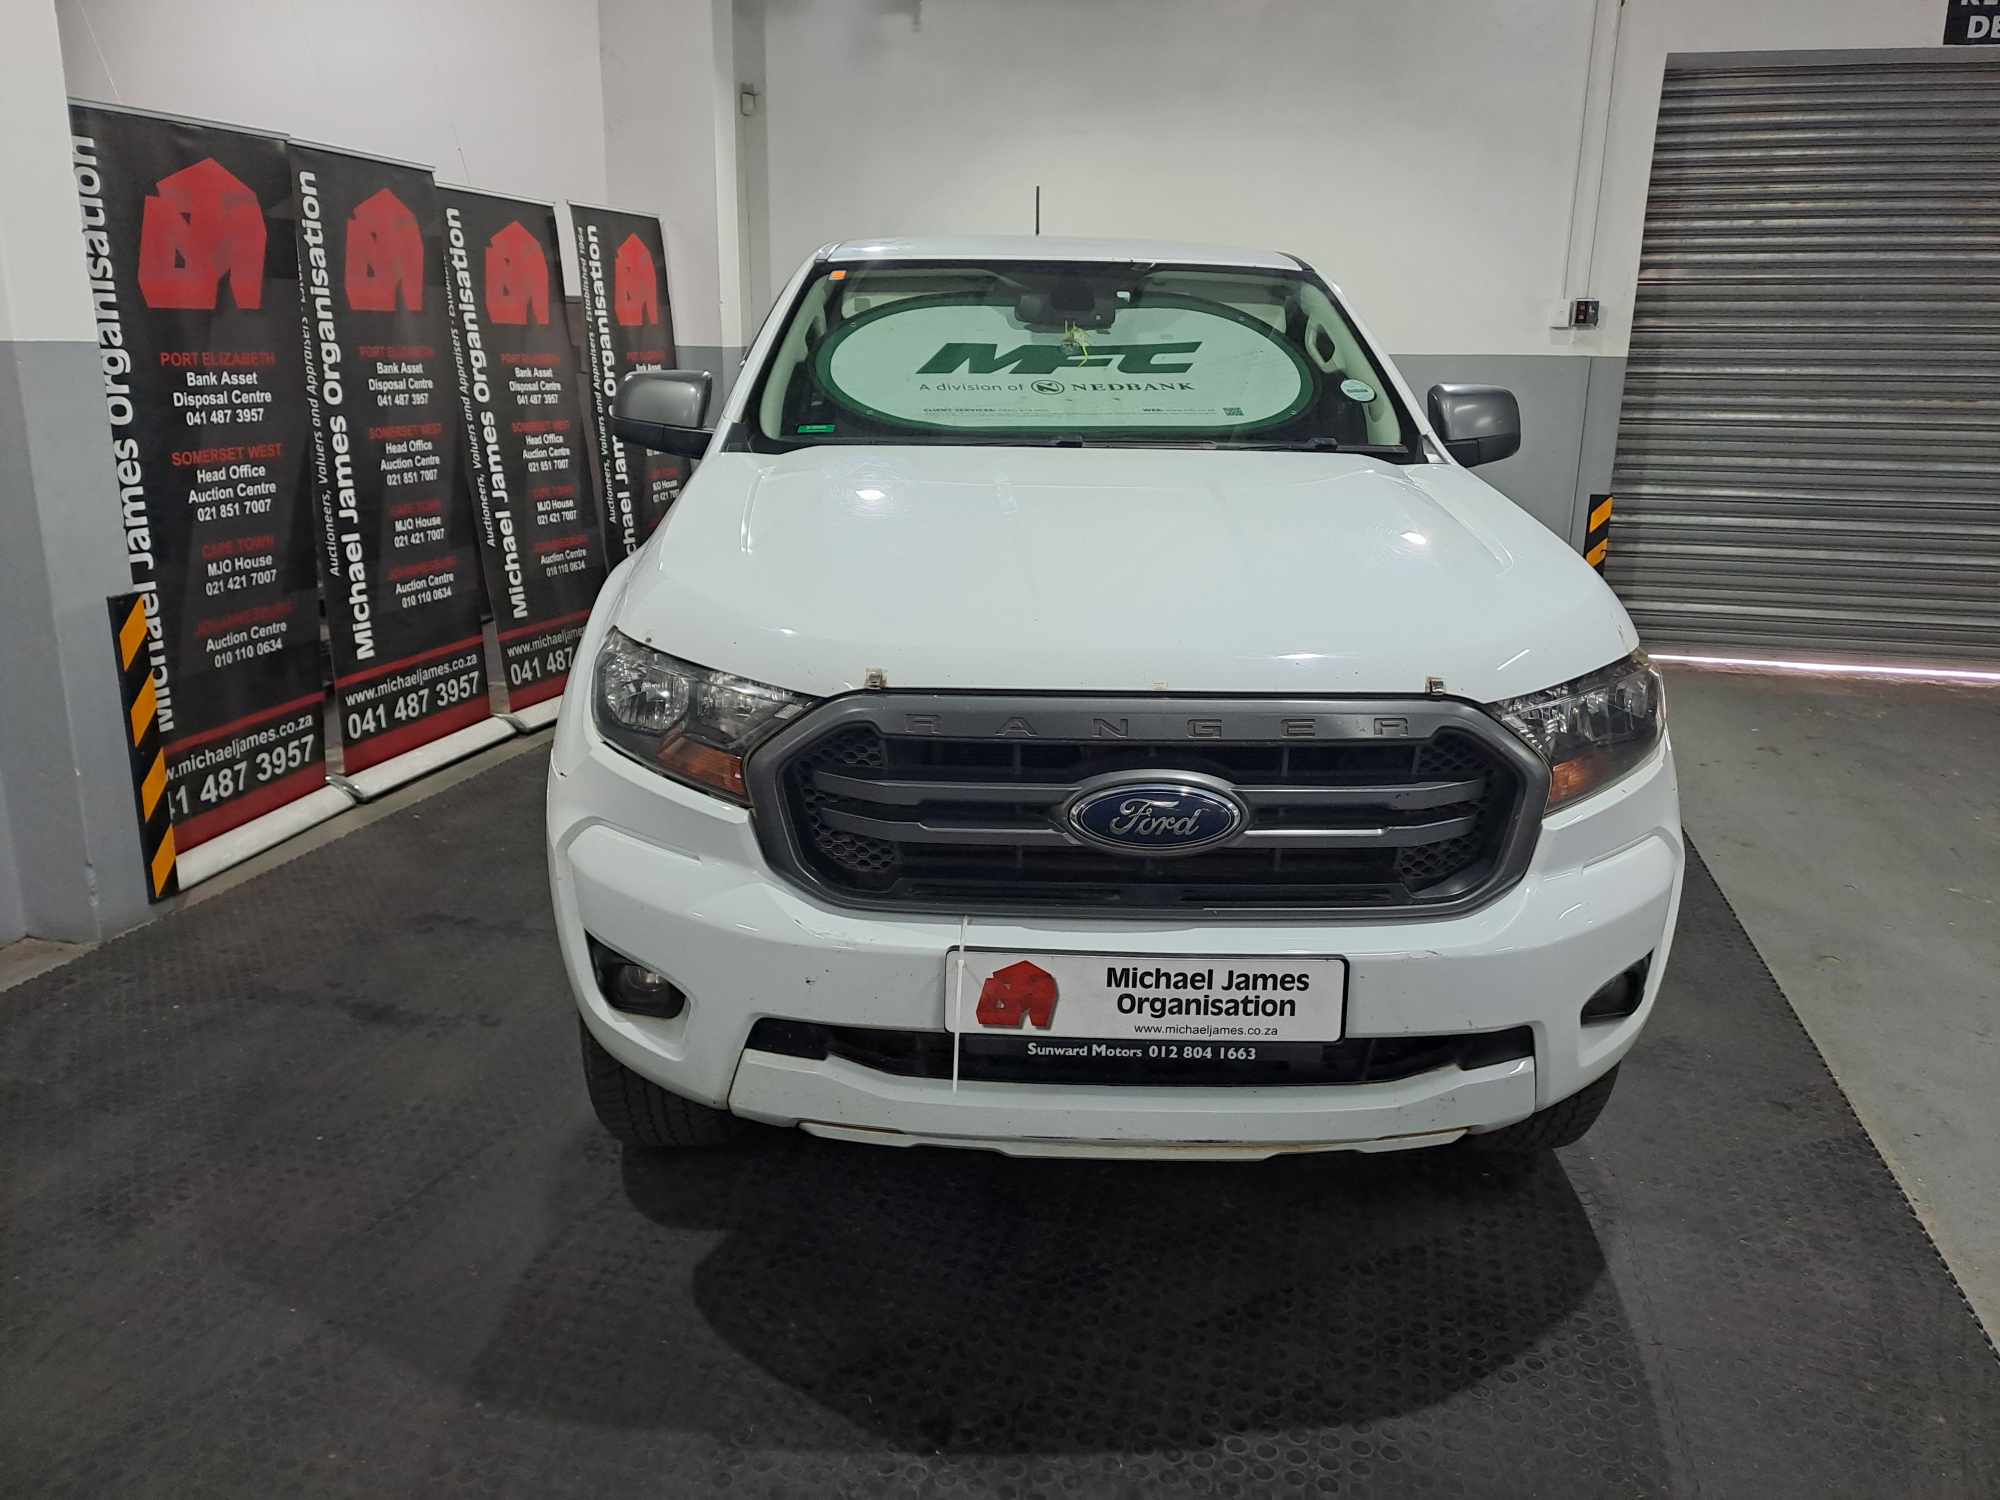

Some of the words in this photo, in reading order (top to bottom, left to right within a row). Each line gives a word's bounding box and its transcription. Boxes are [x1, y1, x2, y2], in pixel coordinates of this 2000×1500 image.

[299, 171, 343, 407] Organisation
[446, 207, 491, 403] Organisation
[586, 224, 617, 397] Organisation
[160, 352, 198, 367] PORT
[376, 362, 399, 374] Bank
[400, 362, 424, 374] Asset
[915, 341, 1202, 374] MFC
[186, 372, 218, 386] Bank
[220, 371, 258, 385] Asset
[368, 378, 406, 392] Disposal
[408, 378, 434, 390] Centre
[919, 382, 932, 392] A
[936, 382, 1002, 392] division
[1007, 382, 1024, 392] of
[1071, 383, 1195, 392] NEDBANK
[172, 391, 228, 408] Disposal
[231, 390, 272, 404] Centre
[460, 396, 474, 421] and
[186, 411, 207, 426] 041
[210, 410, 232, 424] 487
[236, 408, 264, 423] 3957
[309, 398, 323, 428] and
[171, 447, 243, 466] SOMERSET
[247, 443, 282, 459] WEST
[385, 441, 408, 454] Head
[408, 440, 432, 452] Office
[480, 410, 508, 503] James
[196, 466, 226, 484] Head
[229, 464, 266, 480] Office
[329, 414, 359, 524] James
[380, 458, 413, 471] Auction
[415, 455, 440, 467] Centre
[113, 437, 155, 571] James
[188, 486, 234, 504] Auction
[237, 481, 277, 498] Centre
[197, 507, 217, 522] 021
[220, 502, 240, 519] 851
[243, 499, 272, 516] 7007
[617, 491, 637, 555] chael
[207, 559, 232, 577] MJO
[234, 555, 273, 571] House
[495, 510, 528, 619] Michael
[205, 580, 224, 596] 021
[227, 574, 247, 591] 421
[250, 569, 277, 586] 7007
[395, 579, 427, 595] Auction
[428, 572, 454, 586] Centre
[341, 532, 376, 661] Michael
[206, 630, 248, 652] Auction
[250, 621, 287, 640] Centre
[214, 651, 233, 668] 010
[235, 645, 254, 662] 110
[256, 638, 283, 656] 0634
[510, 657, 541, 685] 041
[546, 646, 573, 673] 487
[345, 653, 477, 707] www.michaeljames.co.za
[347, 703, 387, 739] 041
[394, 688, 430, 721] 487
[435, 671, 479, 706] 3957
[905, 713, 1409, 739] RANGER
[200, 760, 248, 803] 487
[255, 734, 315, 781] 3957
[1109, 797, 1203, 838] Ford
[1106, 966, 1213, 990] Michael
[1221, 969, 1310, 992] James
[1116, 992, 1296, 1017] Organisation
[1134, 1023, 1278, 1037] www.michaeljames.co.za
[1027, 1042, 1088, 1057] Sunward
[1091, 1044, 1142, 1058] Motors
[1149, 1045, 1178, 1059] 012
[1183, 1046, 1213, 1060] 804
[1219, 1047, 1256, 1060] 1663
